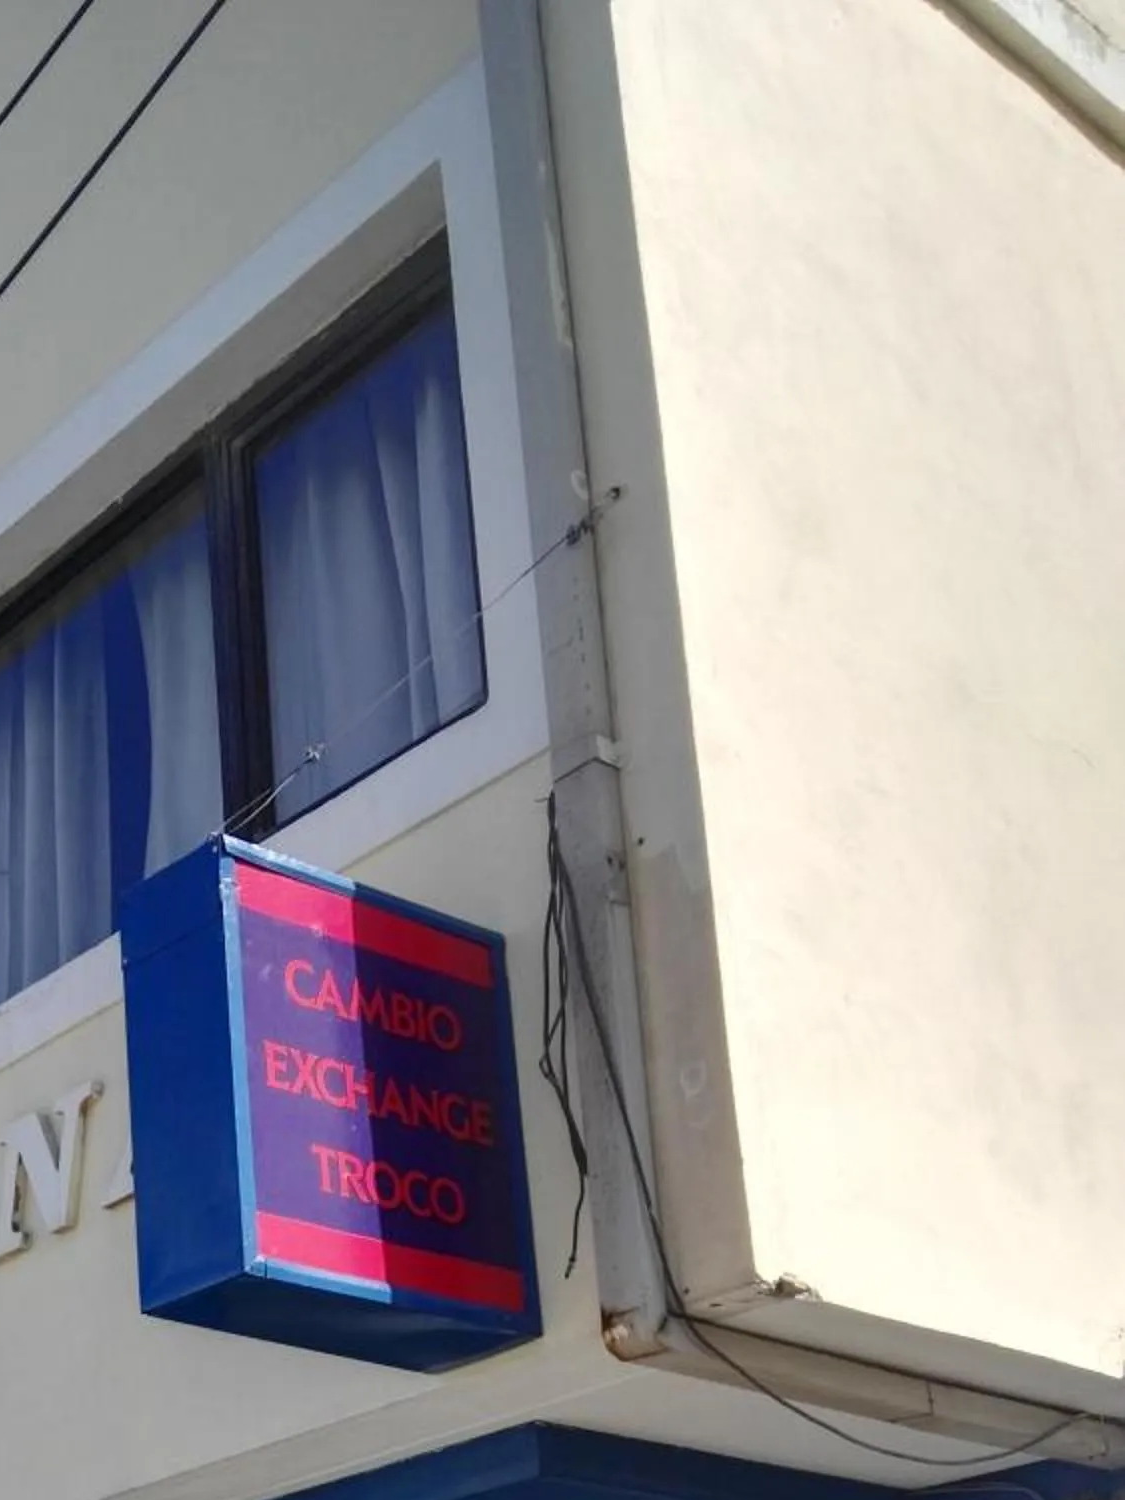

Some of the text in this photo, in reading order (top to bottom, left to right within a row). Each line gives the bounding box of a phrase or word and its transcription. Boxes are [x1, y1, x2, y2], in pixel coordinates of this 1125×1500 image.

[283, 958, 463, 1051] CAMBIO
[262, 1040, 495, 1147] EXCHANGE
[311, 1142, 466, 1225] TROCO
